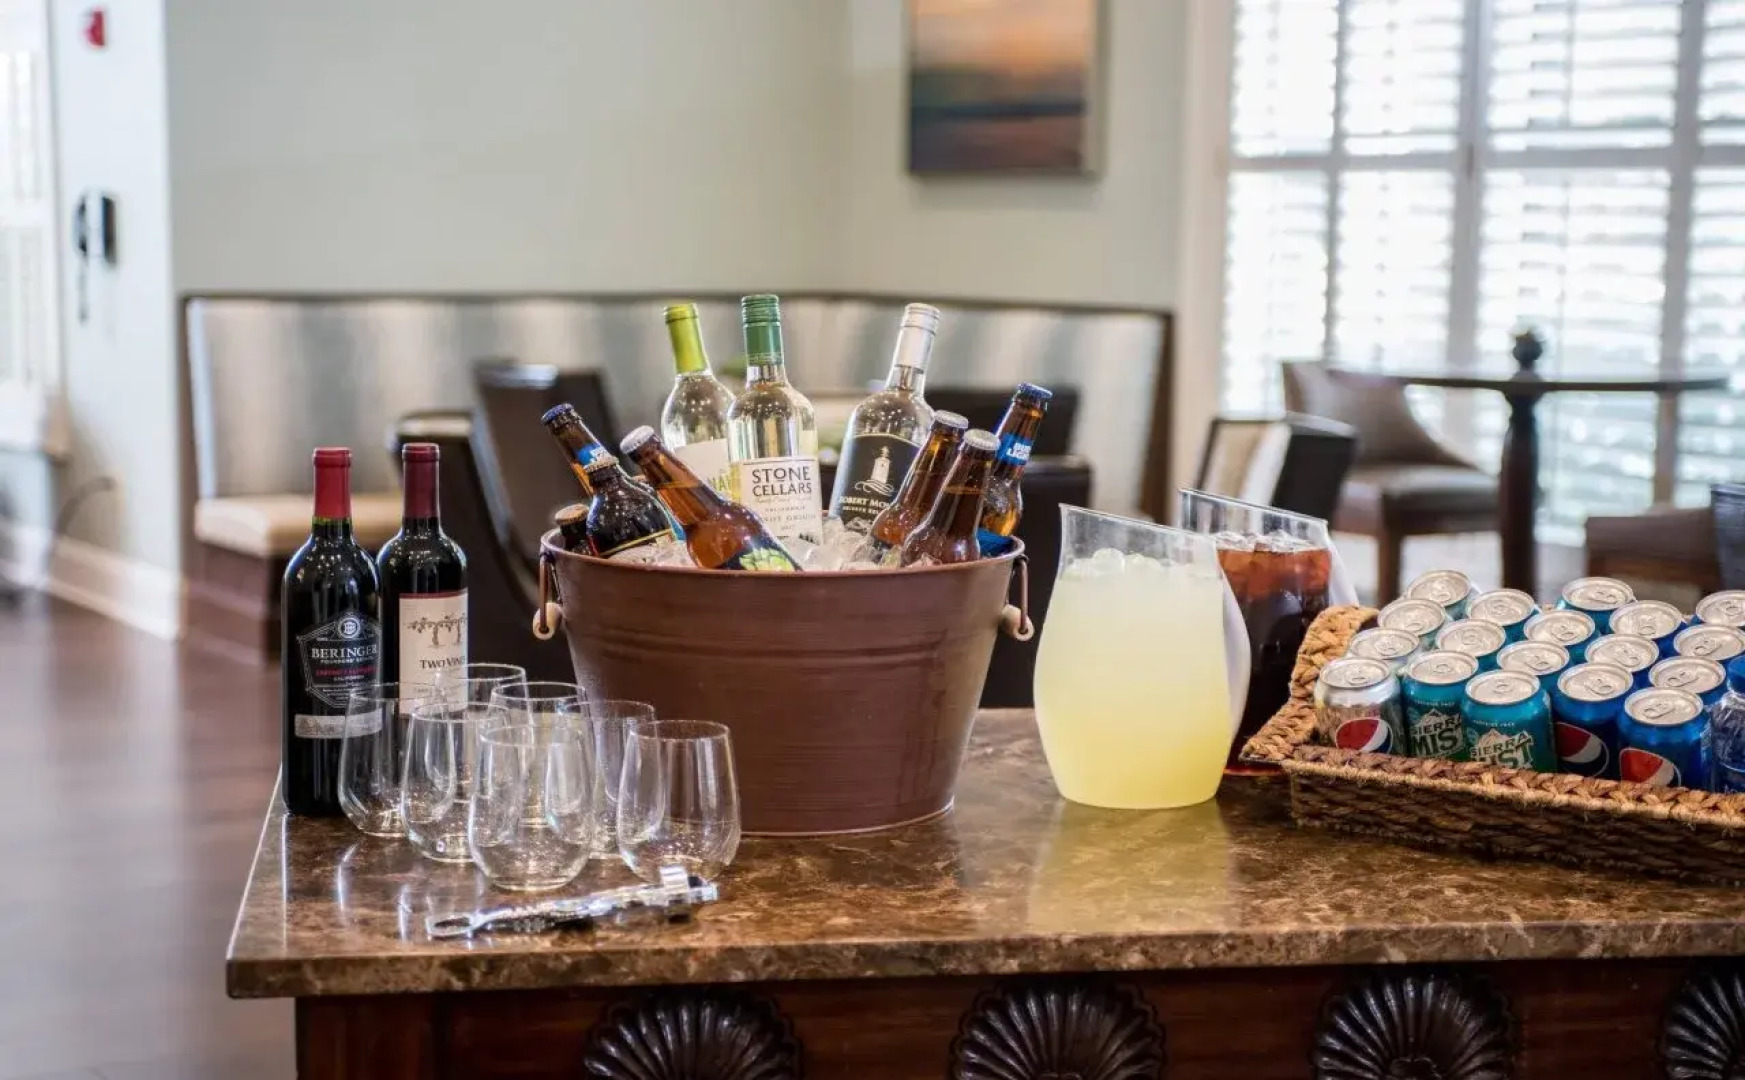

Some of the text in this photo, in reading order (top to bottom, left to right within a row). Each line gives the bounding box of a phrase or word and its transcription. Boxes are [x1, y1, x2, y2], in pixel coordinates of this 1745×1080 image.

[751, 466, 811, 485] STONE
[752, 482, 812, 497] CELLARS
[311, 644, 377, 658] BERINGER
[420, 659, 445, 669] TWO
[1411, 727, 1459, 757] MIS
[1470, 733, 1530, 757] SIERRA
